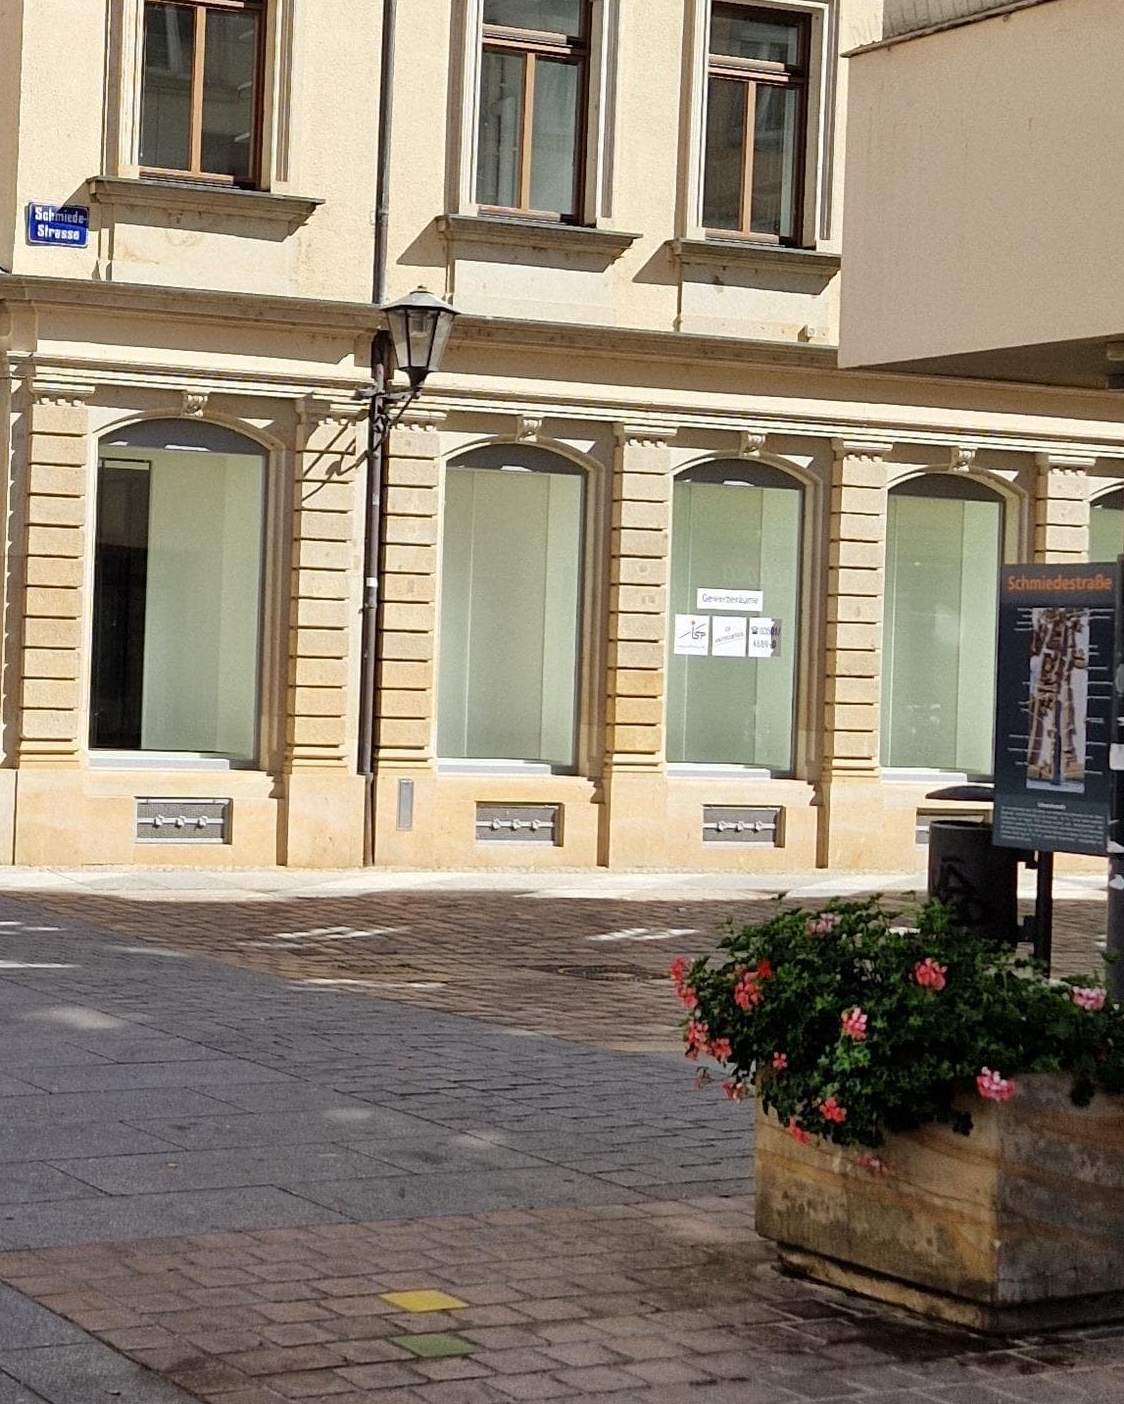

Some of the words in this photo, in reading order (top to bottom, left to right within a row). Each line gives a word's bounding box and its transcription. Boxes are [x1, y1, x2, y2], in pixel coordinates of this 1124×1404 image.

[35, 206, 87, 224] Schmiede-
[37, 224, 80, 240] Strasse
[1007, 573, 1113, 592] Schmiedestraße
